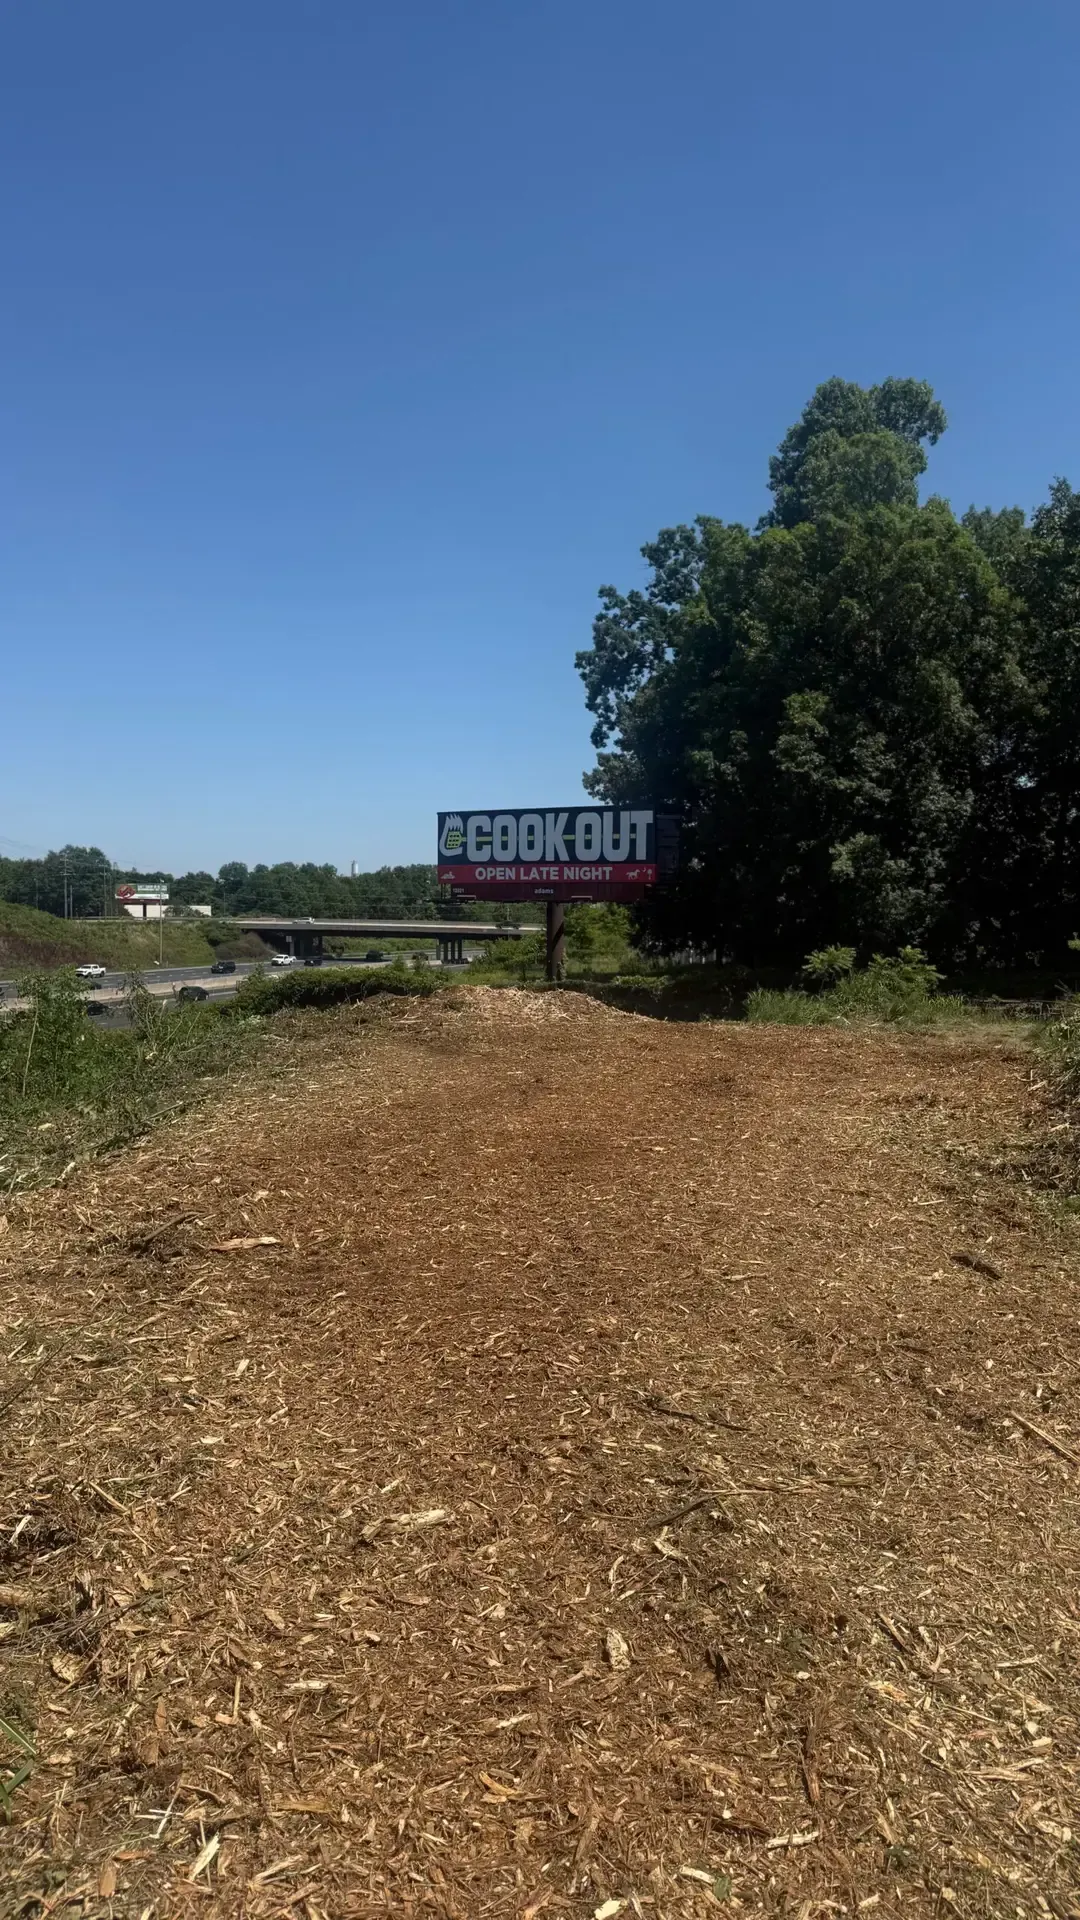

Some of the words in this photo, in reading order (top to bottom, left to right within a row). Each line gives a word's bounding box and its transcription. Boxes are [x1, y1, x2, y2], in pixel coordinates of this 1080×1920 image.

[466, 812, 570, 862] COOK
[575, 810, 654, 862] OUT
[475, 867, 516, 881] OPEN
[520, 867, 559, 881] LATE
[563, 866, 613, 881] NIGHT
[534, 887, 554, 895] adams
